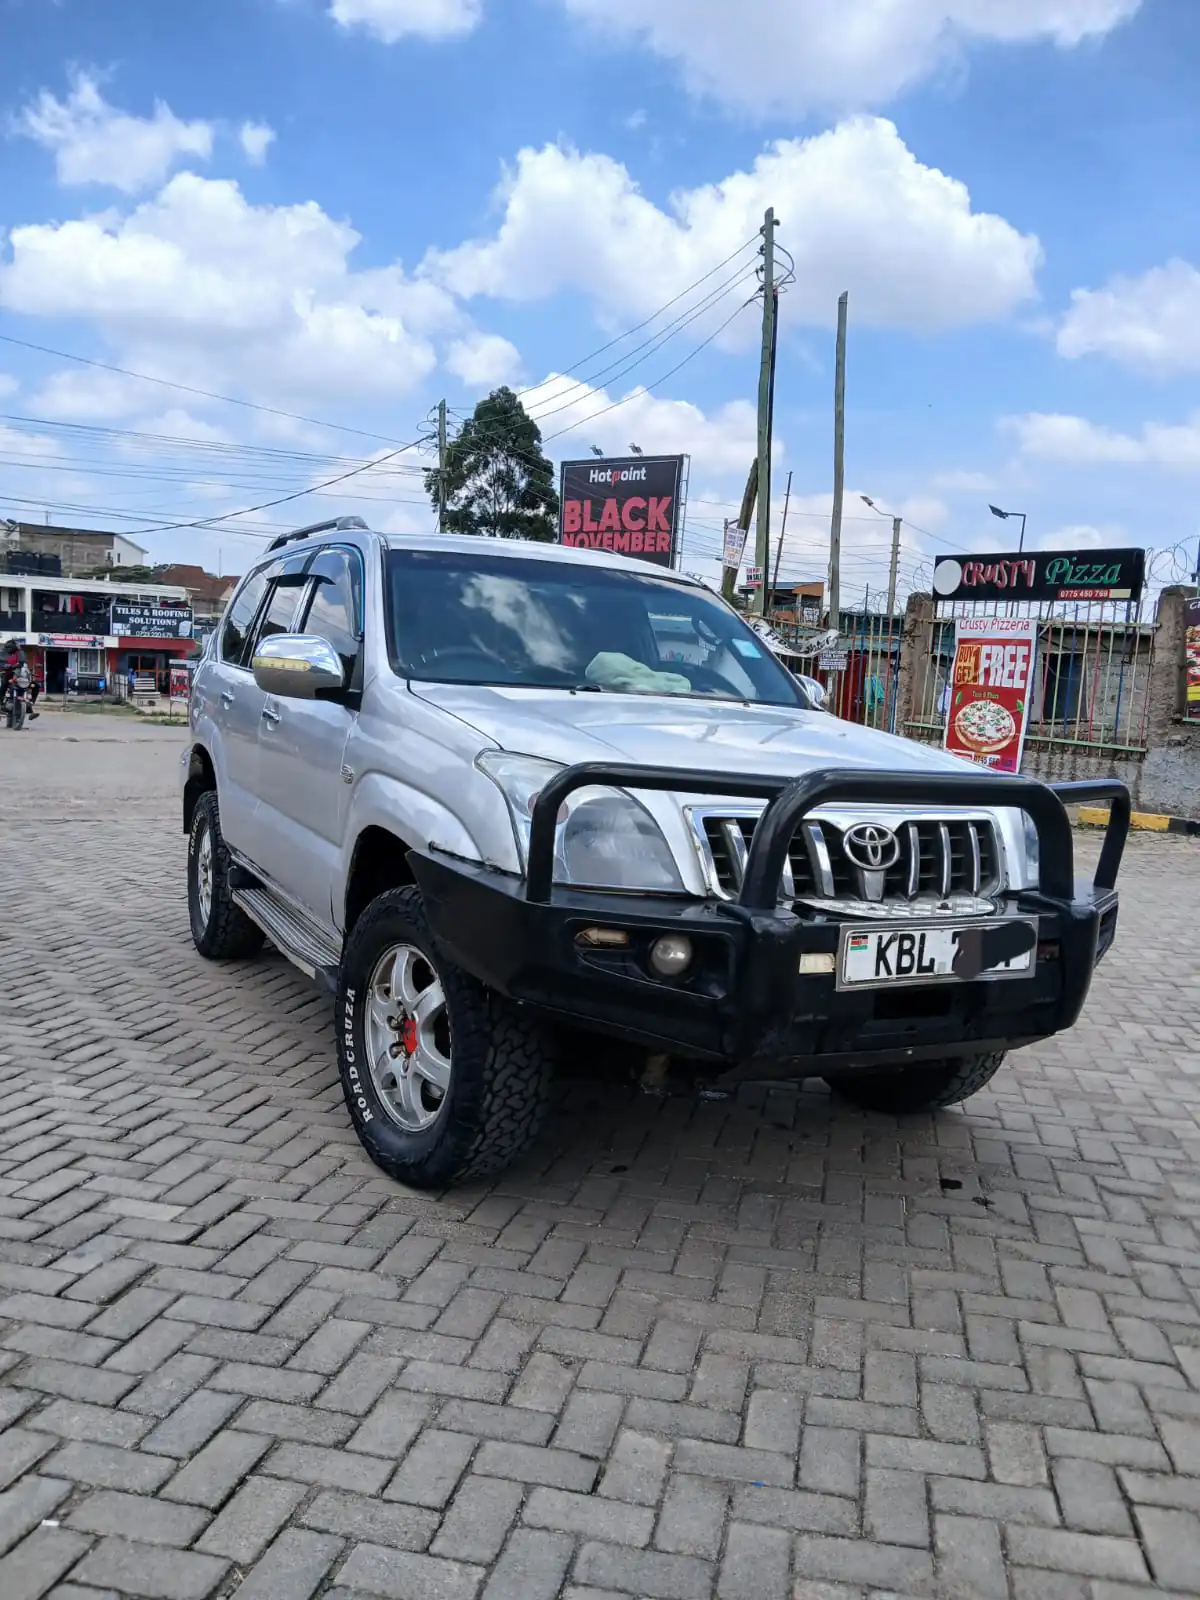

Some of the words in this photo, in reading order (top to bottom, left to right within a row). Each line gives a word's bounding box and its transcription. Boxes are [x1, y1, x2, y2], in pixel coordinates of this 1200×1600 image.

[588, 466, 647, 487] Hotpoint
[563, 496, 673, 532] BLACK
[562, 531, 670, 553] NOVEMBER
[962, 559, 1036, 588] CRUSTY
[1045, 557, 1121, 586] Pizza
[1060, 589, 1078, 598] 0775
[116, 607, 142, 615] TILES
[143, 608, 150, 616] &
[152, 609, 190, 618] ROOFING
[128, 617, 178, 626] SOLUTIONS
[959, 618, 988, 633] Crusty
[990, 617, 1030, 631] Pizzeria
[959, 645, 974, 663] BUY
[979, 645, 1029, 689] FREE
[875, 932, 936, 977] KBL
[344, 987, 374, 1123] ROADCRUZA
